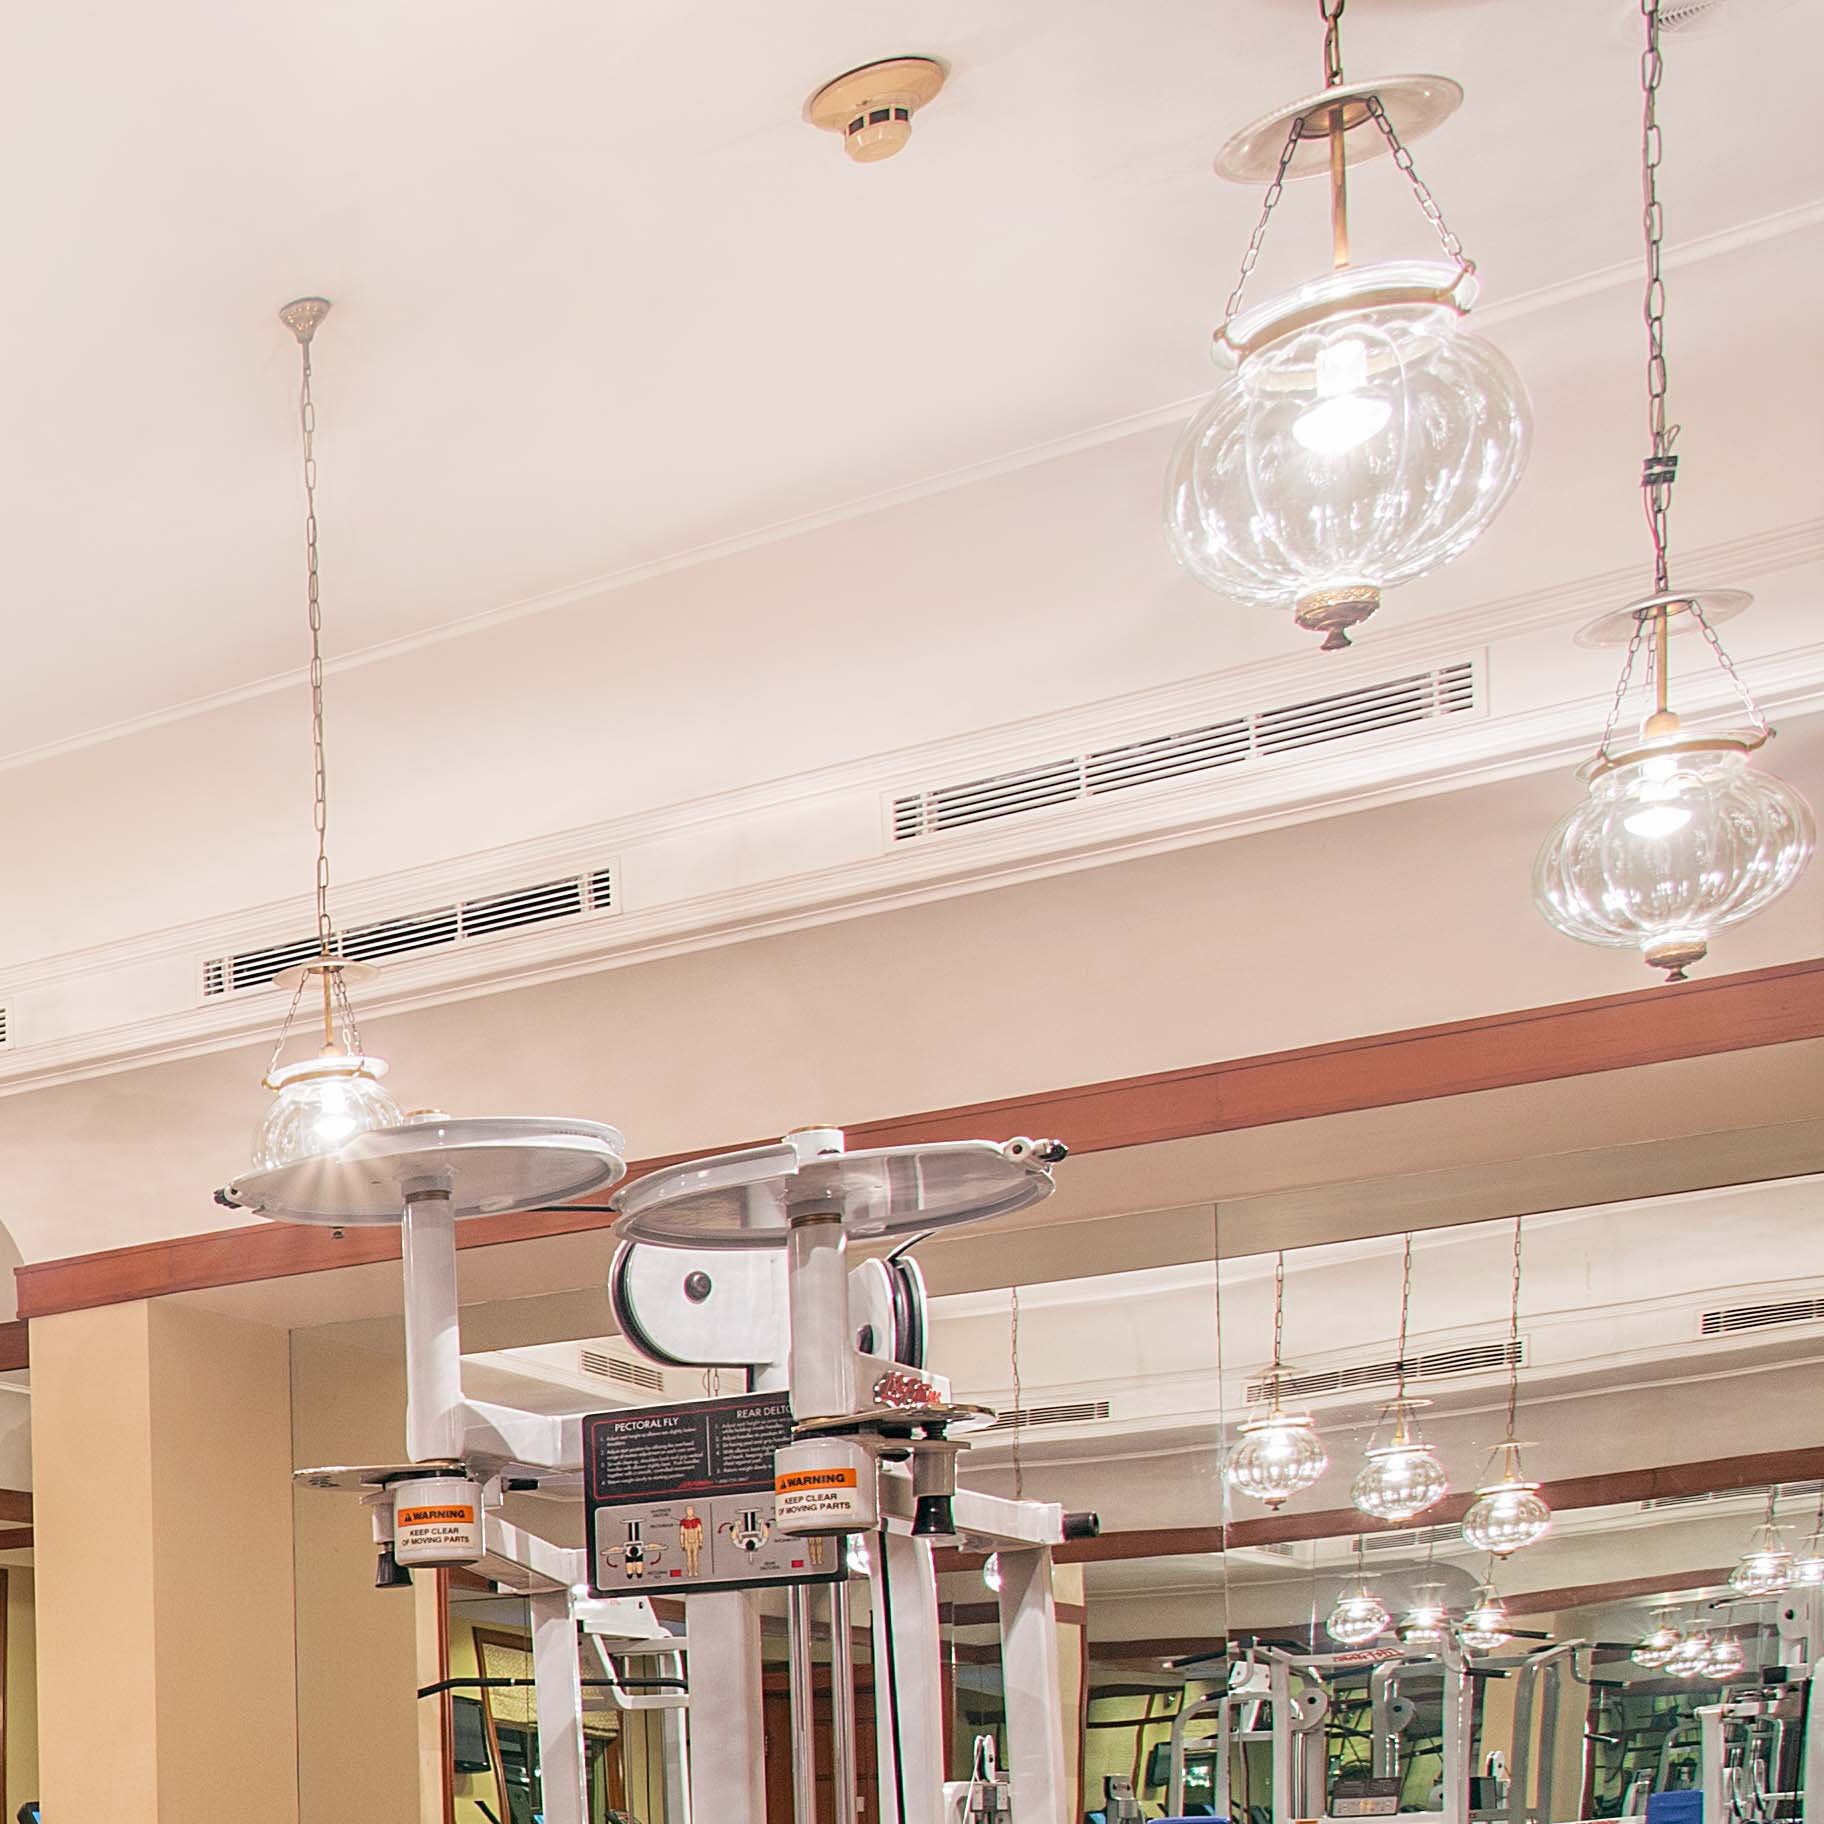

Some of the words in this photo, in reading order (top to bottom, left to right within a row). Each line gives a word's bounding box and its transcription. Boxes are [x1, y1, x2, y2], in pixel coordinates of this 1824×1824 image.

[736, 1407, 762, 1419] REAR
[614, 1418, 662, 1433] PECTORAL
[663, 1416, 679, 1427] FLY
[787, 1473, 846, 1486] WARNING
[805, 1493, 838, 1502] CLEAR
[785, 1503, 818, 1515] MOVING
[819, 1501, 851, 1511] PARTS
[412, 1509, 465, 1520] WARNING
[409, 1527, 430, 1537] KEEP
[431, 1526, 459, 1536] CLEAR
[411, 1536, 442, 1545] MOVING
[443, 1535, 470, 1544] PARTS
